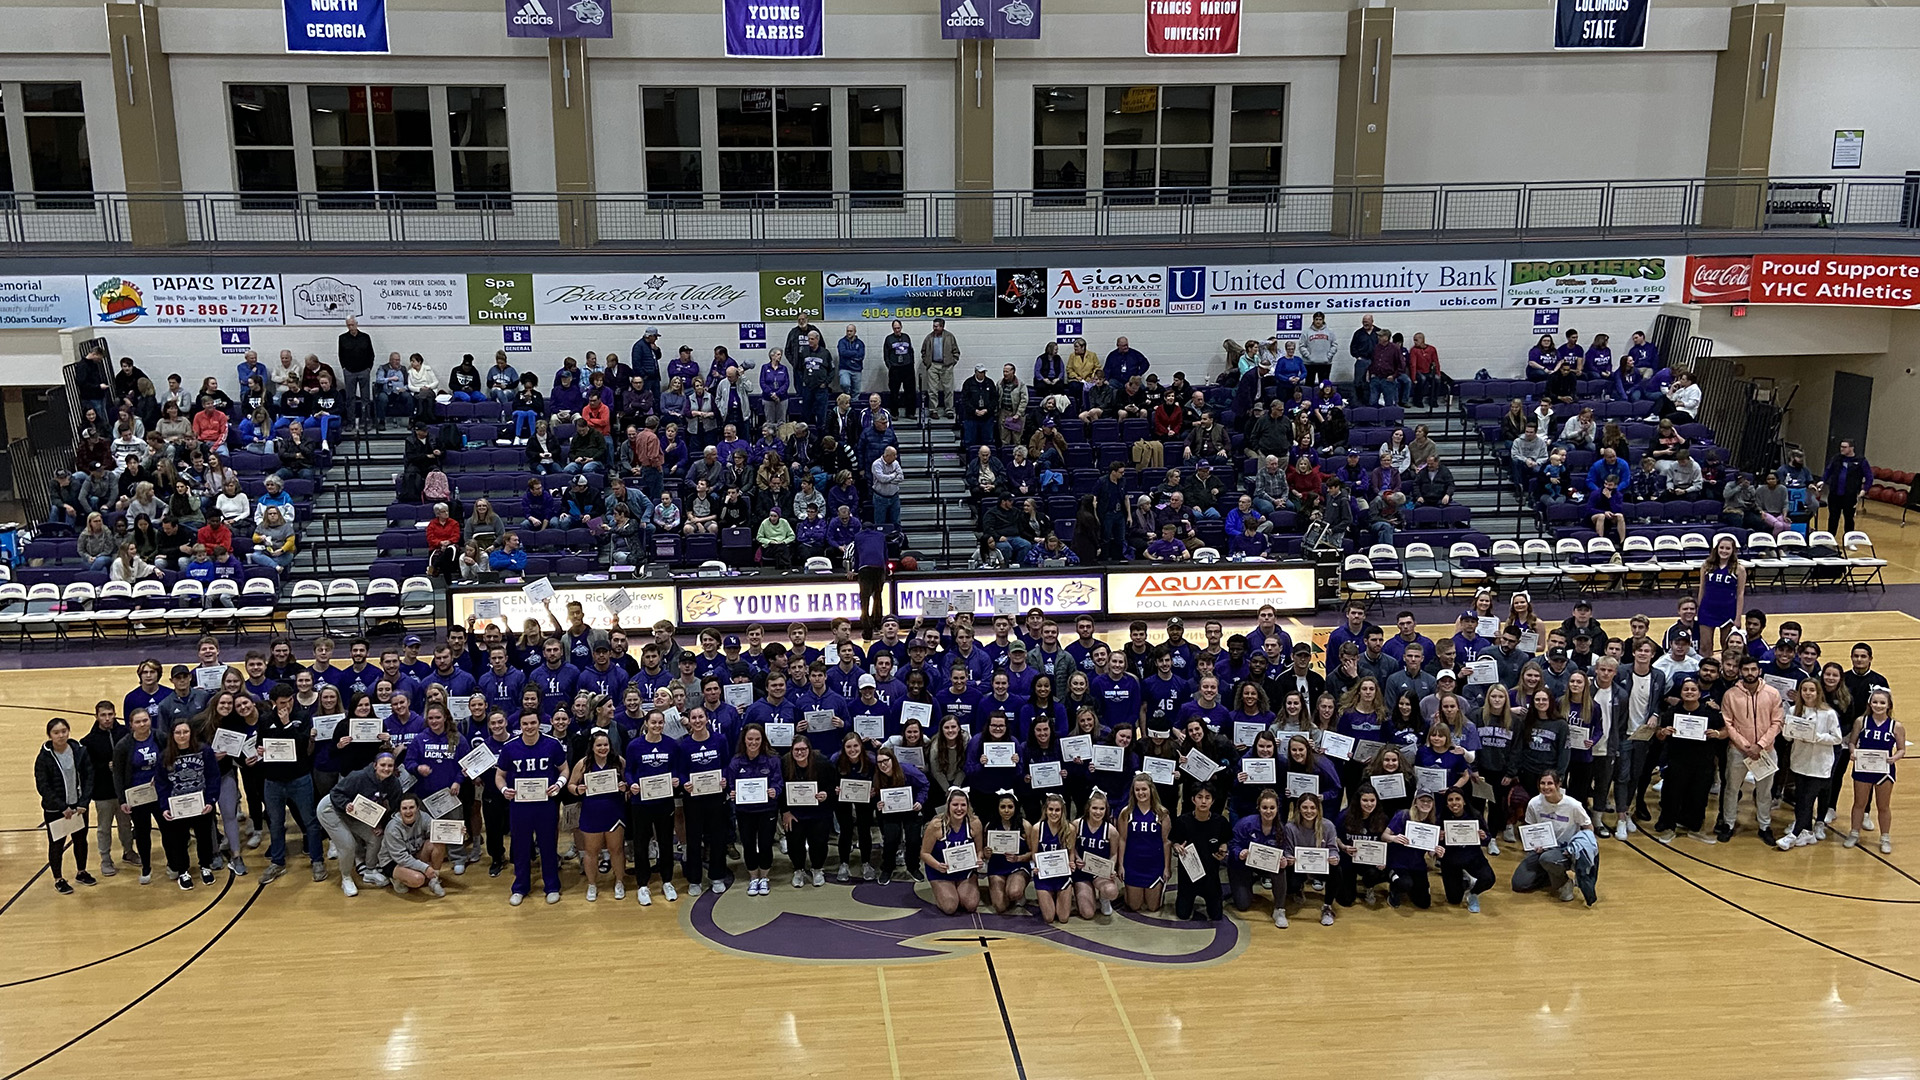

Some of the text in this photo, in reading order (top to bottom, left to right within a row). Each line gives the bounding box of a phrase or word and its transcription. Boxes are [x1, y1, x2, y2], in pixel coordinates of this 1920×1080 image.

[311, 0, 358, 11] NORTH
[1150, 1, 1237, 15] FRANCIS MARION
[1574, 0, 1630, 12] COLUMBUS
[748, 5, 800, 20] YOUNG
[512, 14, 553, 26] adidas
[946, 15, 985, 27] adidas
[307, 24, 367, 39] GEORGIA
[746, 25, 804, 39] HARRIS
[1164, 27, 1222, 41] UNIVERSITY
[1582, 20, 1617, 39] STATE
[1509, 258, 1666, 286] BROTHER'S
[1761, 260, 1821, 276] Proud
[826, 273, 864, 288] Century
[886, 273, 992, 287] Jo Ellen Thornton
[1209, 264, 1498, 293] United Community Bank
[1693, 263, 1751, 286] Coca-Cola
[152, 277, 276, 291] PAPA'S PIZZA
[485, 278, 515, 290] Spa
[774, 276, 807, 286] Golf
[1050, 269, 1162, 299] Asiano
[1172, 269, 1202, 299] U
[423, 289, 432, 297] GA
[434, 289, 453, 297] 30512
[860, 282, 871, 295] 21
[905, 288, 975, 298] Associate Broker
[1592, 286, 1631, 294] Chicken
[1761, 282, 1912, 300] YHC Athletics
[28, 293, 60, 303] Church
[543, 283, 750, 308] Brasstown Valley
[1439, 296, 1498, 306] ucbi.com
[1511, 295, 1661, 306] 706-379-1272
[386, 302, 448, 311] 706-745-6450
[584, 303, 656, 311] RESORT
[681, 303, 711, 311] SPA
[1169, 303, 1202, 312] UNITED
[1211, 298, 1411, 311] #1 In Customer Satisfaction
[478, 310, 527, 322] Dining
[570, 312, 726, 322] www.BrasstownValley.com
[764, 307, 820, 317] Stables
[862, 306, 962, 318] 404-680-6549
[31, 315, 67, 325] Sundays
[1285, 320, 1293, 330] E
[1542, 314, 1551, 324] F
[748, 329, 757, 339] C
[1065, 324, 1074, 334] D
[230, 333, 241, 343] A
[512, 331, 522, 342] B
[1135, 574, 1285, 595] AQUATICA
[1705, 573, 1732, 584] YHC
[502, 594, 561, 605] CENY
[733, 592, 863, 614] YOUNG HARR
[1136, 599, 1169, 609] POOL
[1158, 699, 1173, 711] 46
[1864, 728, 1890, 742] YHC
[514, 757, 550, 773] YHC
[1131, 821, 1157, 833] YHC
[1079, 836, 1105, 850] YHC
